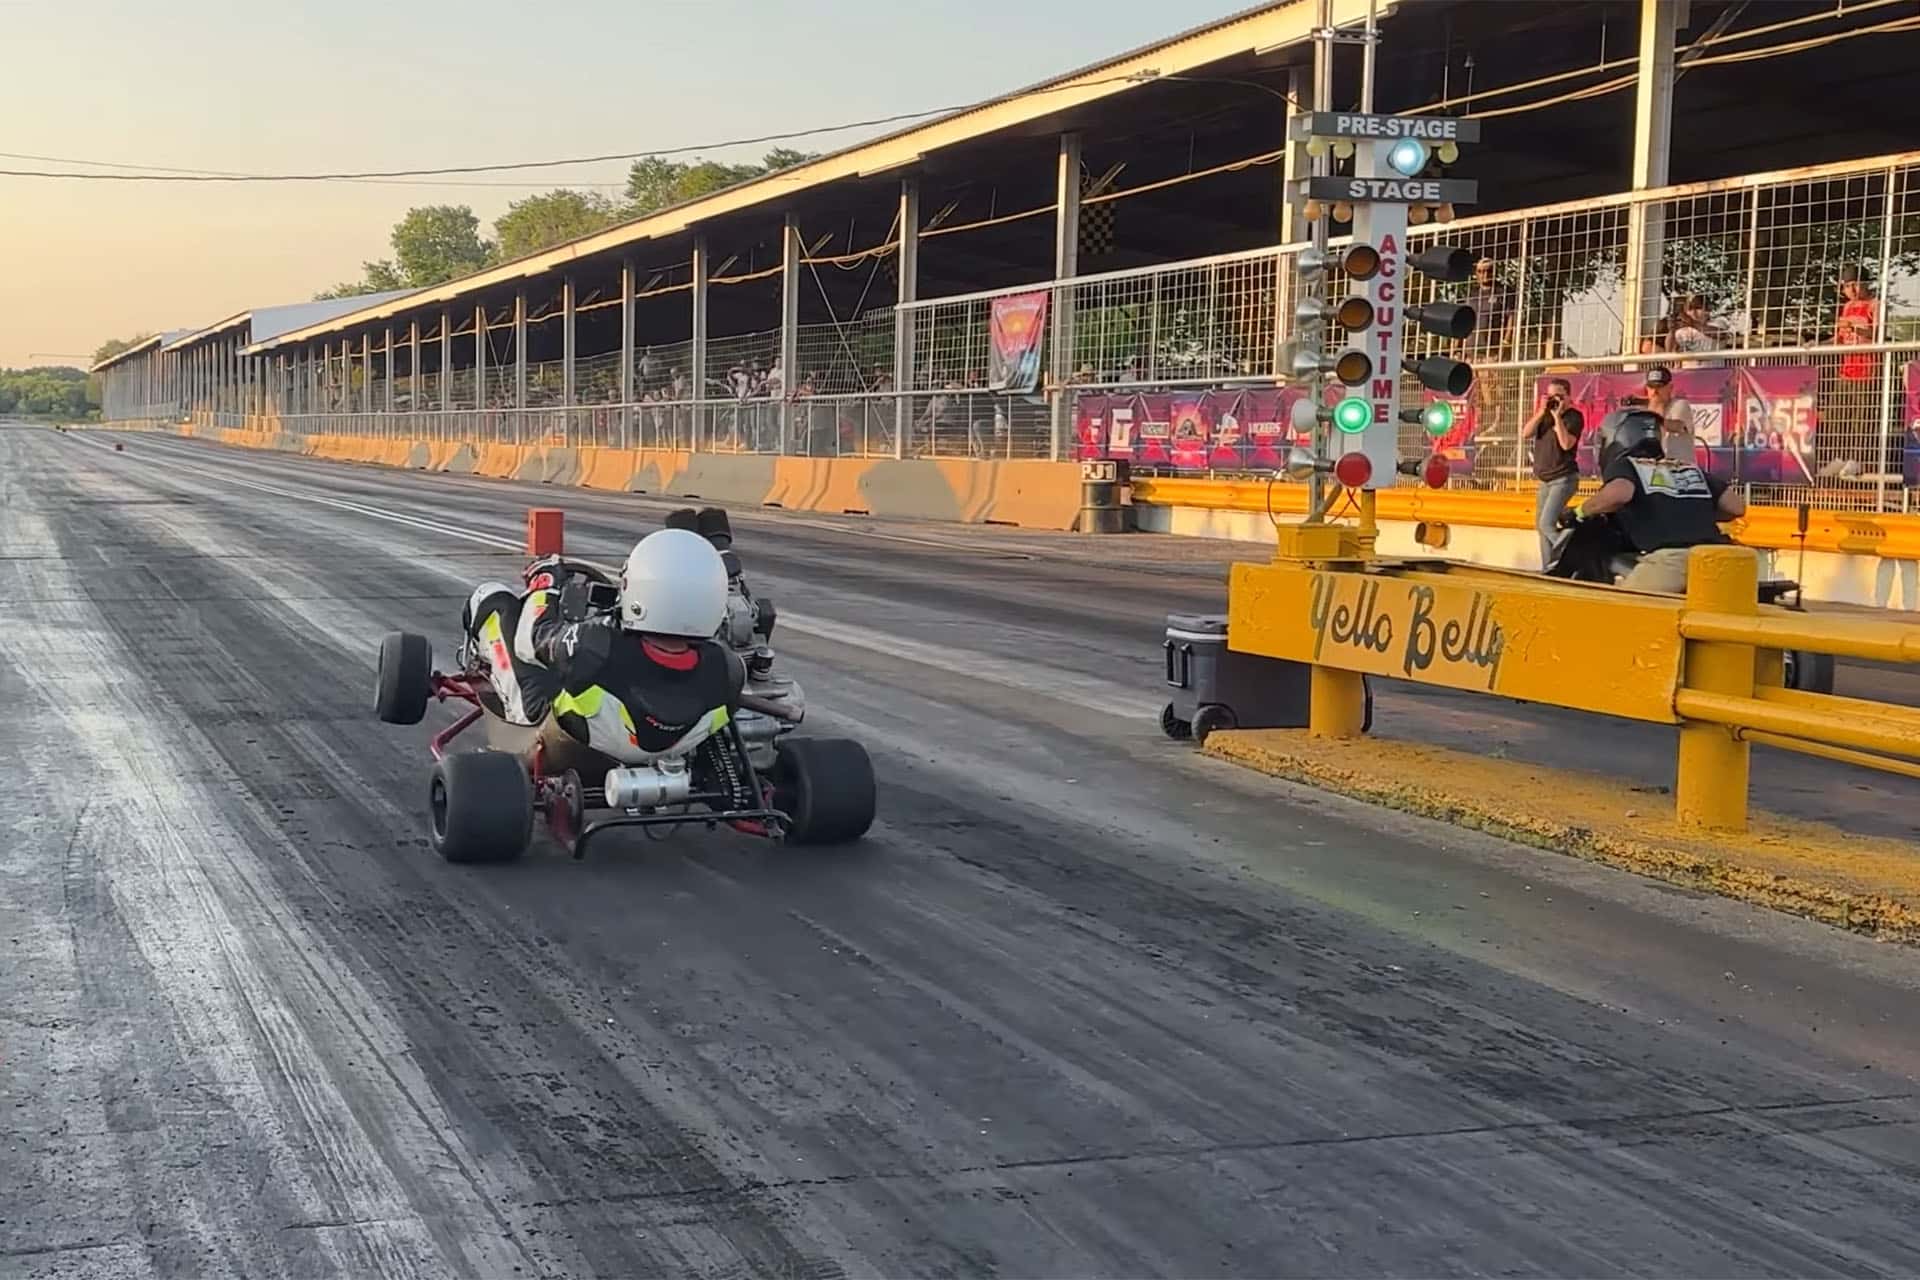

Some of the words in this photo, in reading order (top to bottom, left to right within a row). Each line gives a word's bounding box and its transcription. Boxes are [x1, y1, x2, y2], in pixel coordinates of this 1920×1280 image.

[1336, 115, 1457, 138] PRE-STAGE
[1349, 180, 1440, 200] STAGE
[1372, 233, 1397, 424] ACCUTIME
[1081, 463, 1114, 480] PJ1
[1310, 574, 1393, 661] Yello
[1403, 584, 1502, 691] Belly
